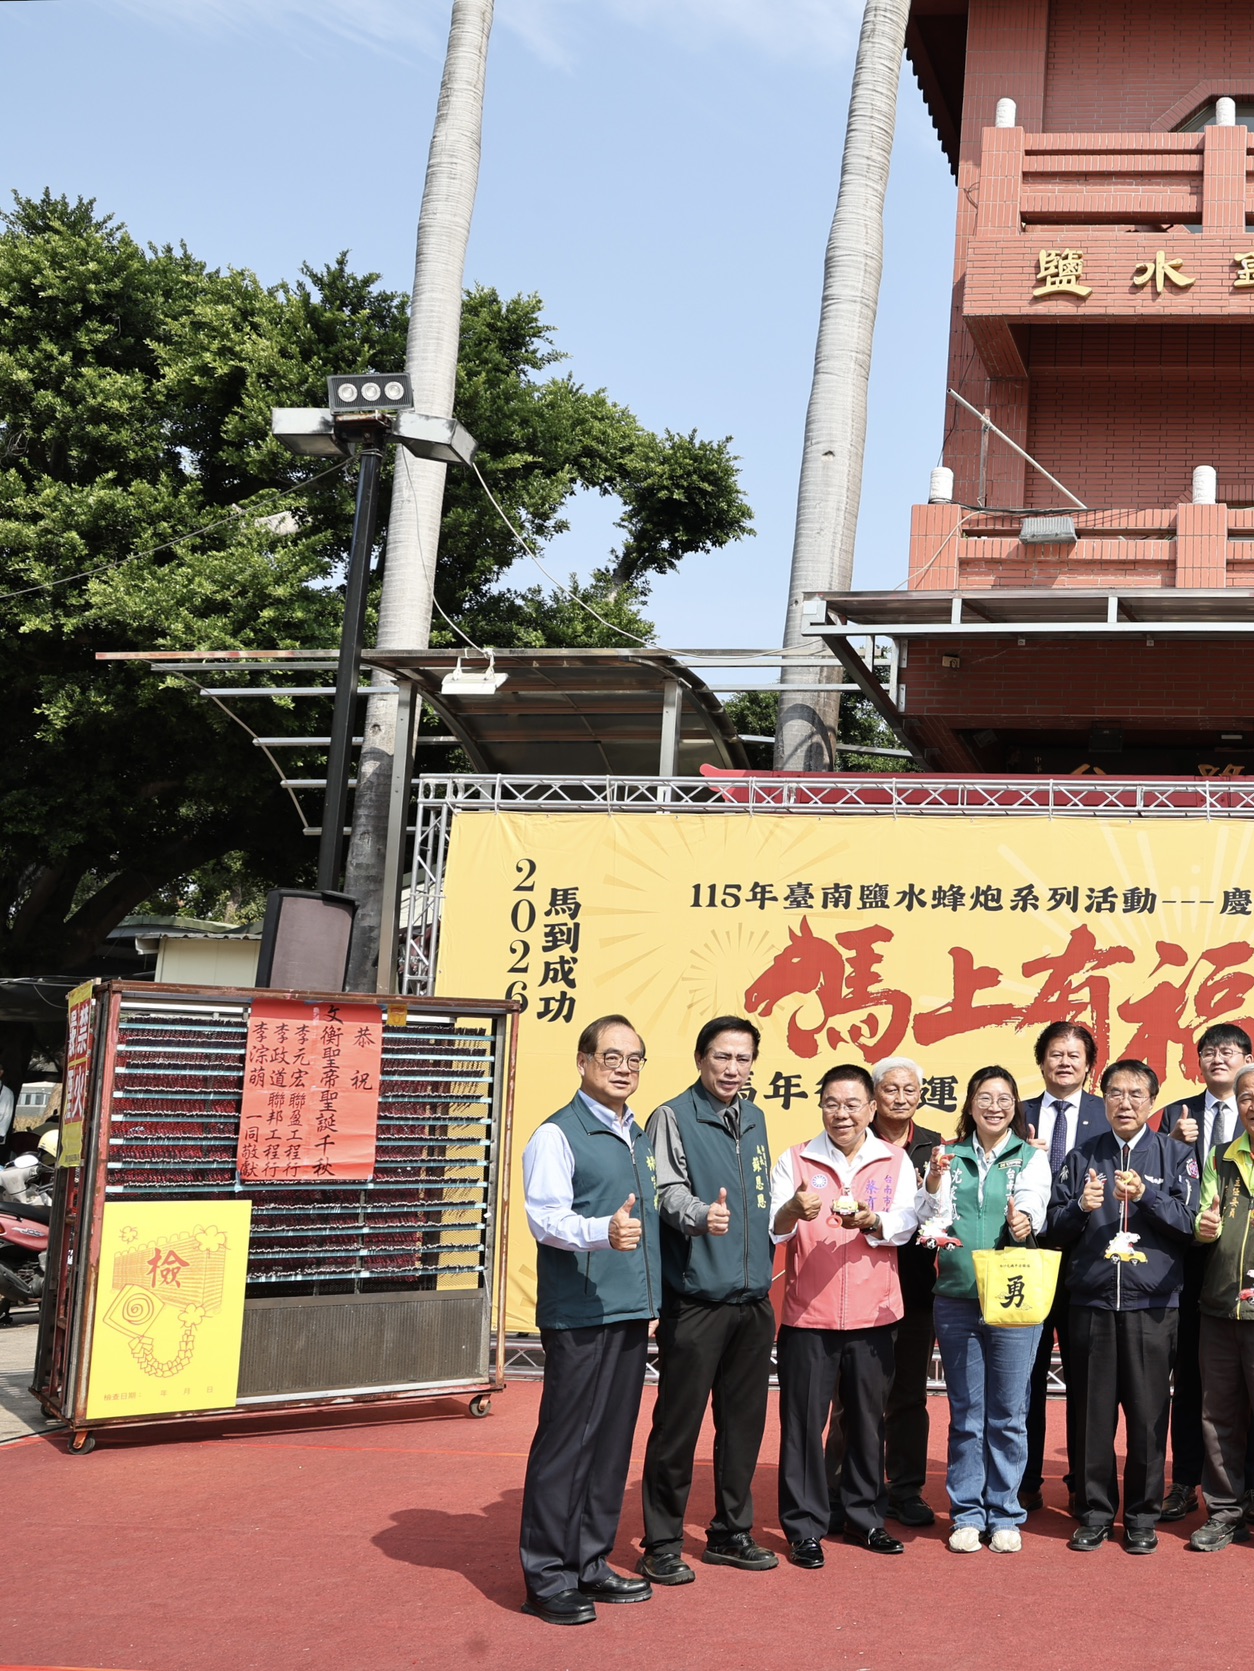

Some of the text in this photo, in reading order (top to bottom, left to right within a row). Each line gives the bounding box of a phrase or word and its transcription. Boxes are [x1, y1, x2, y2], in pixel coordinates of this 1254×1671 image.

[505, 858, 537, 1014] 2026
[537, 886, 582, 1024] 馬到成功
[311, 1004, 344, 1177] 文衡聖帝聖誕千秋
[350, 1026, 376, 1091] 恭祝
[239, 1114, 263, 1178] 一同敬獻
[147, 1247, 190, 1289] 檢
[1000, 1274, 1025, 1309] 勇
